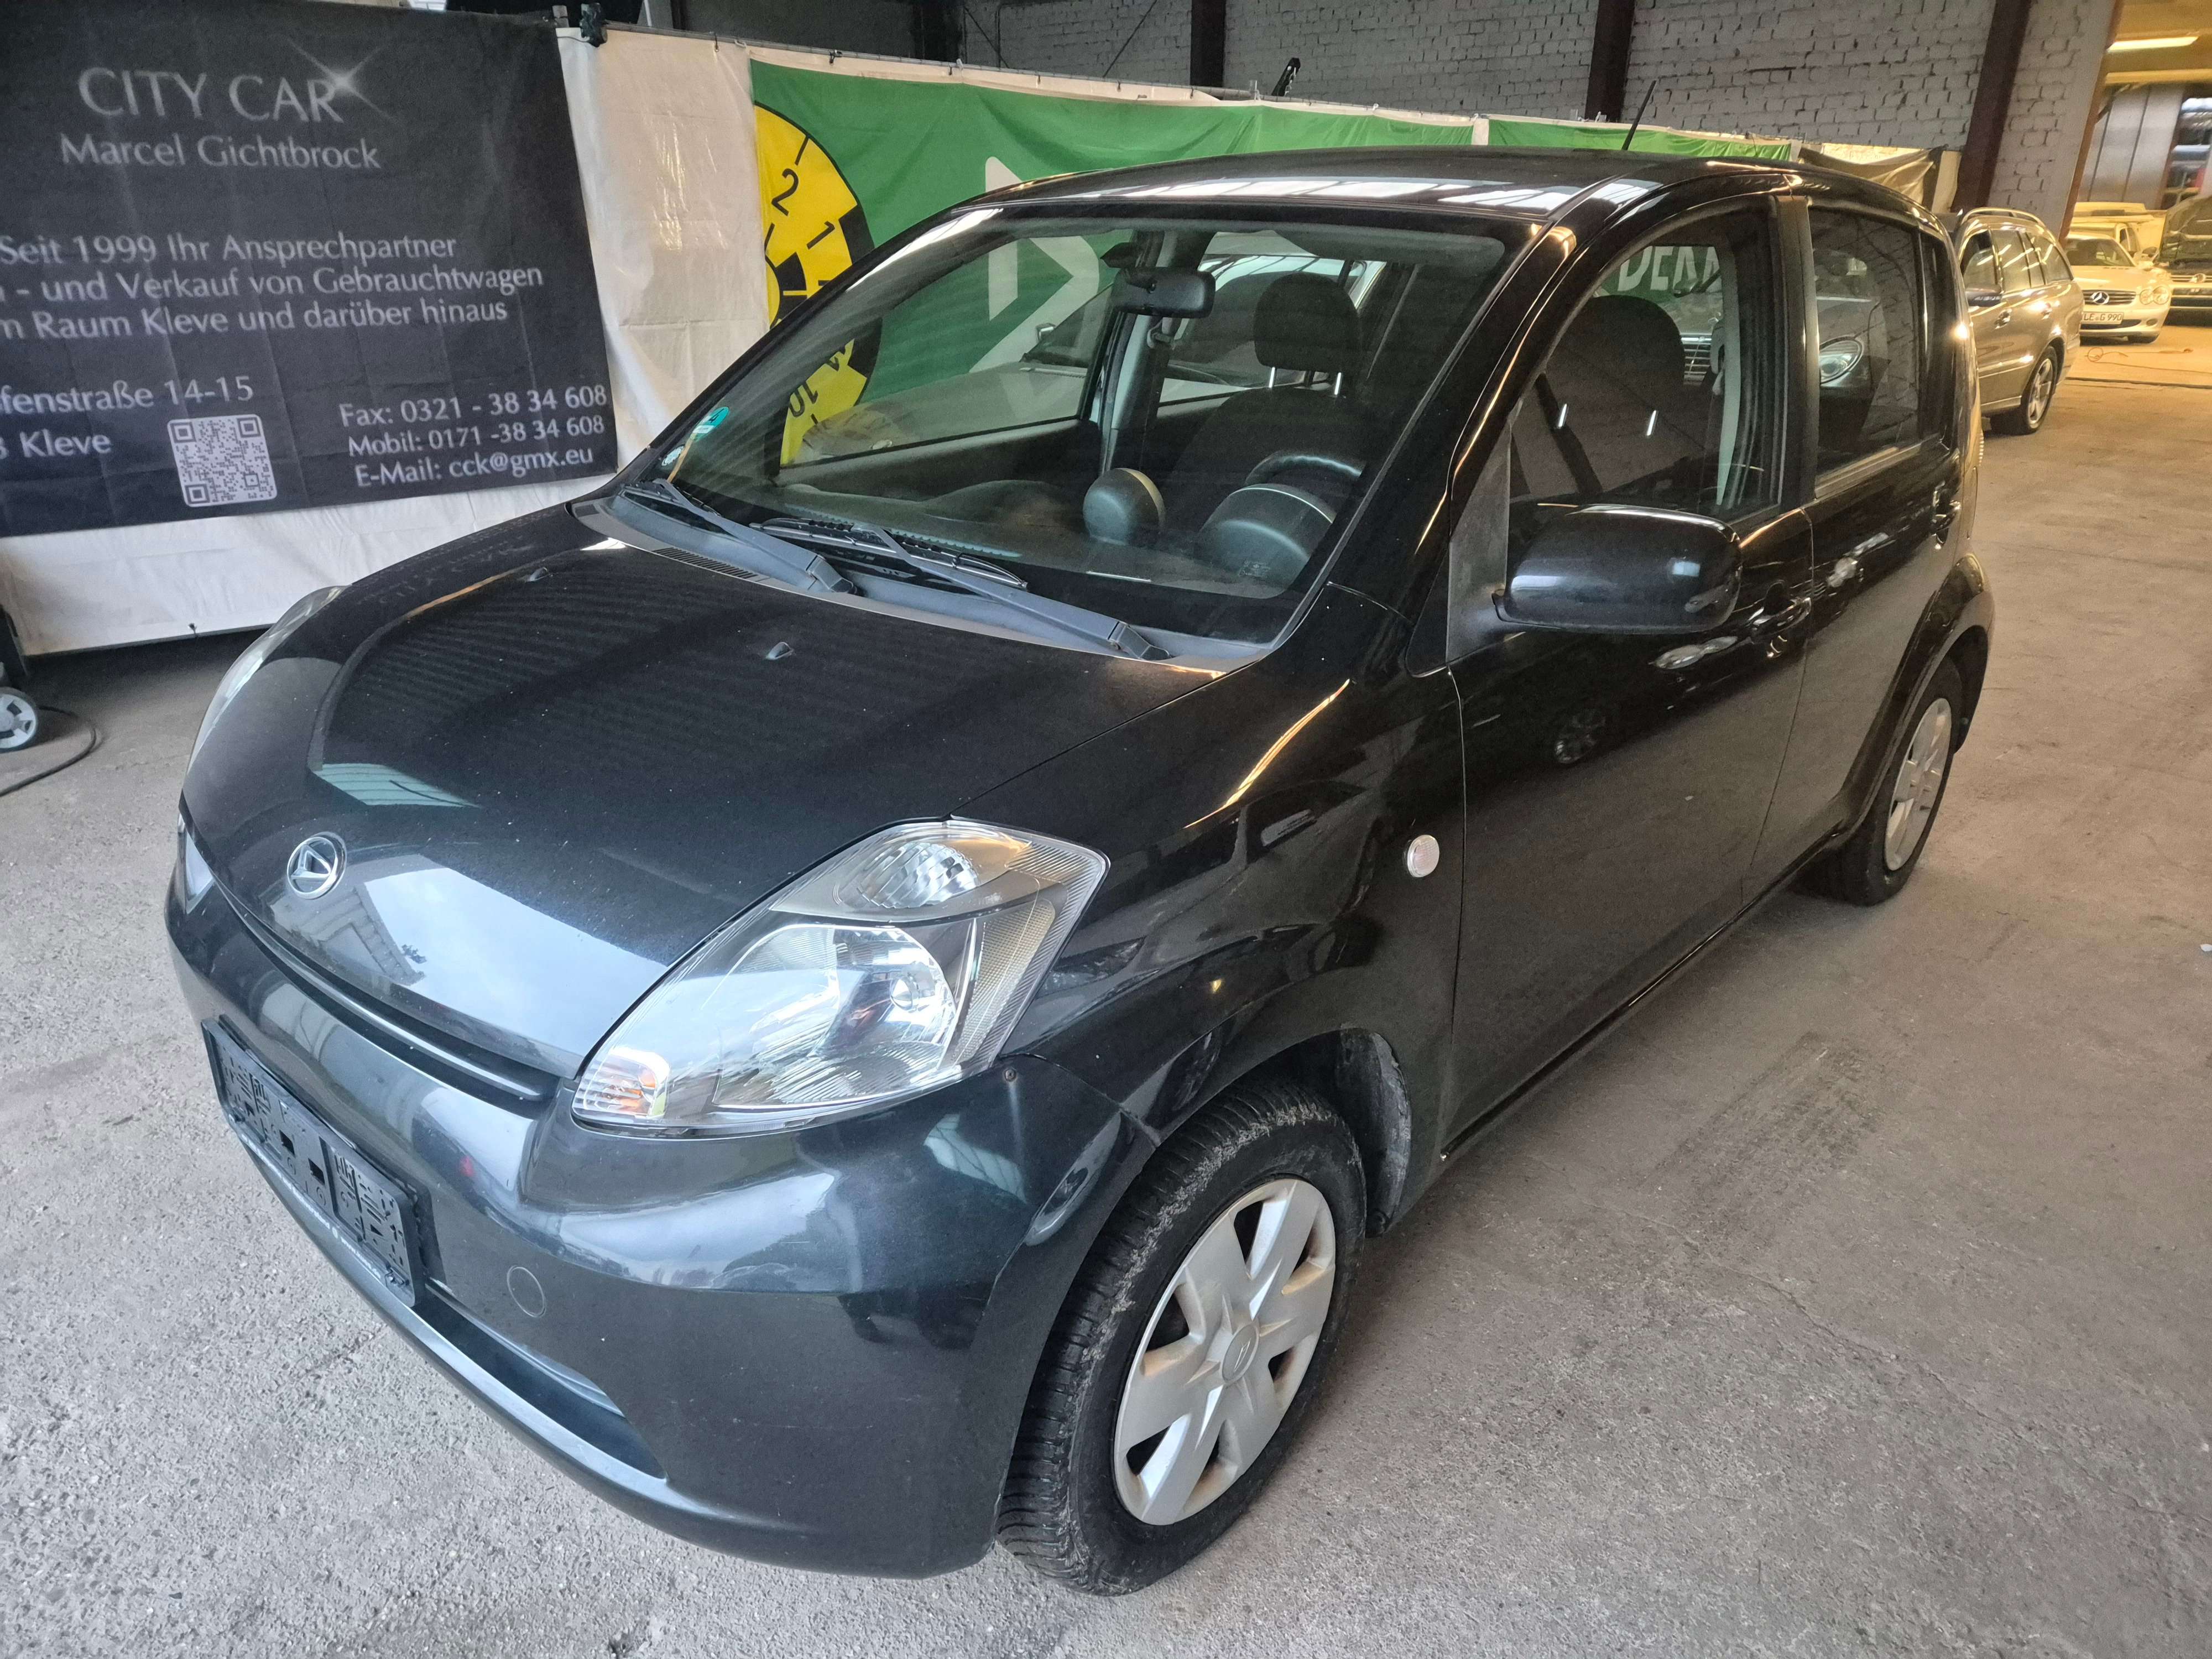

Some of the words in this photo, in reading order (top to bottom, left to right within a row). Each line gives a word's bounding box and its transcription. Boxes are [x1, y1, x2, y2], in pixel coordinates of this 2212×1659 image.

[79, 67, 207, 119] CITY
[229, 75, 343, 123] CAR
[61, 133, 185, 165] Marcel
[197, 133, 381, 169] Gichtbrock
[771, 168, 799, 216] 2
[0, 234, 62, 265] Seit
[73, 234, 156, 263] 1999
[168, 232, 210, 261] Ihr
[223, 230, 456, 268] Ansprechpartner
[41, 270, 108, 301] und
[116, 268, 239, 299] Verkauf
[248, 276, 304, 295] von
[313, 264, 544, 296] Gebrauchtwagen
[32, 310, 132, 339] Raum
[141, 306, 228, 335] Kleve
[238, 301, 295, 331] und
[304, 299, 411, 328] darüber
[420, 297, 508, 325] hinaus
[0, 380, 154, 415] fenstraße
[164, 375, 253, 406] 14-15
[338, 403, 394, 427] Fax:
[400, 397, 461, 423] 0321
[488, 392, 519, 416] 38
[527, 389, 557, 413] 34
[565, 384, 607, 409] 608
[19, 429, 111, 458] Kleve
[348, 430, 422, 457] Mobil:
[429, 426, 481, 450] 0171
[533, 419, 560, 440] 34
[566, 415, 605, 436] 608
[354, 456, 440, 487] E-Mail:
[448, 447, 593, 478] cck@gmx.eu
